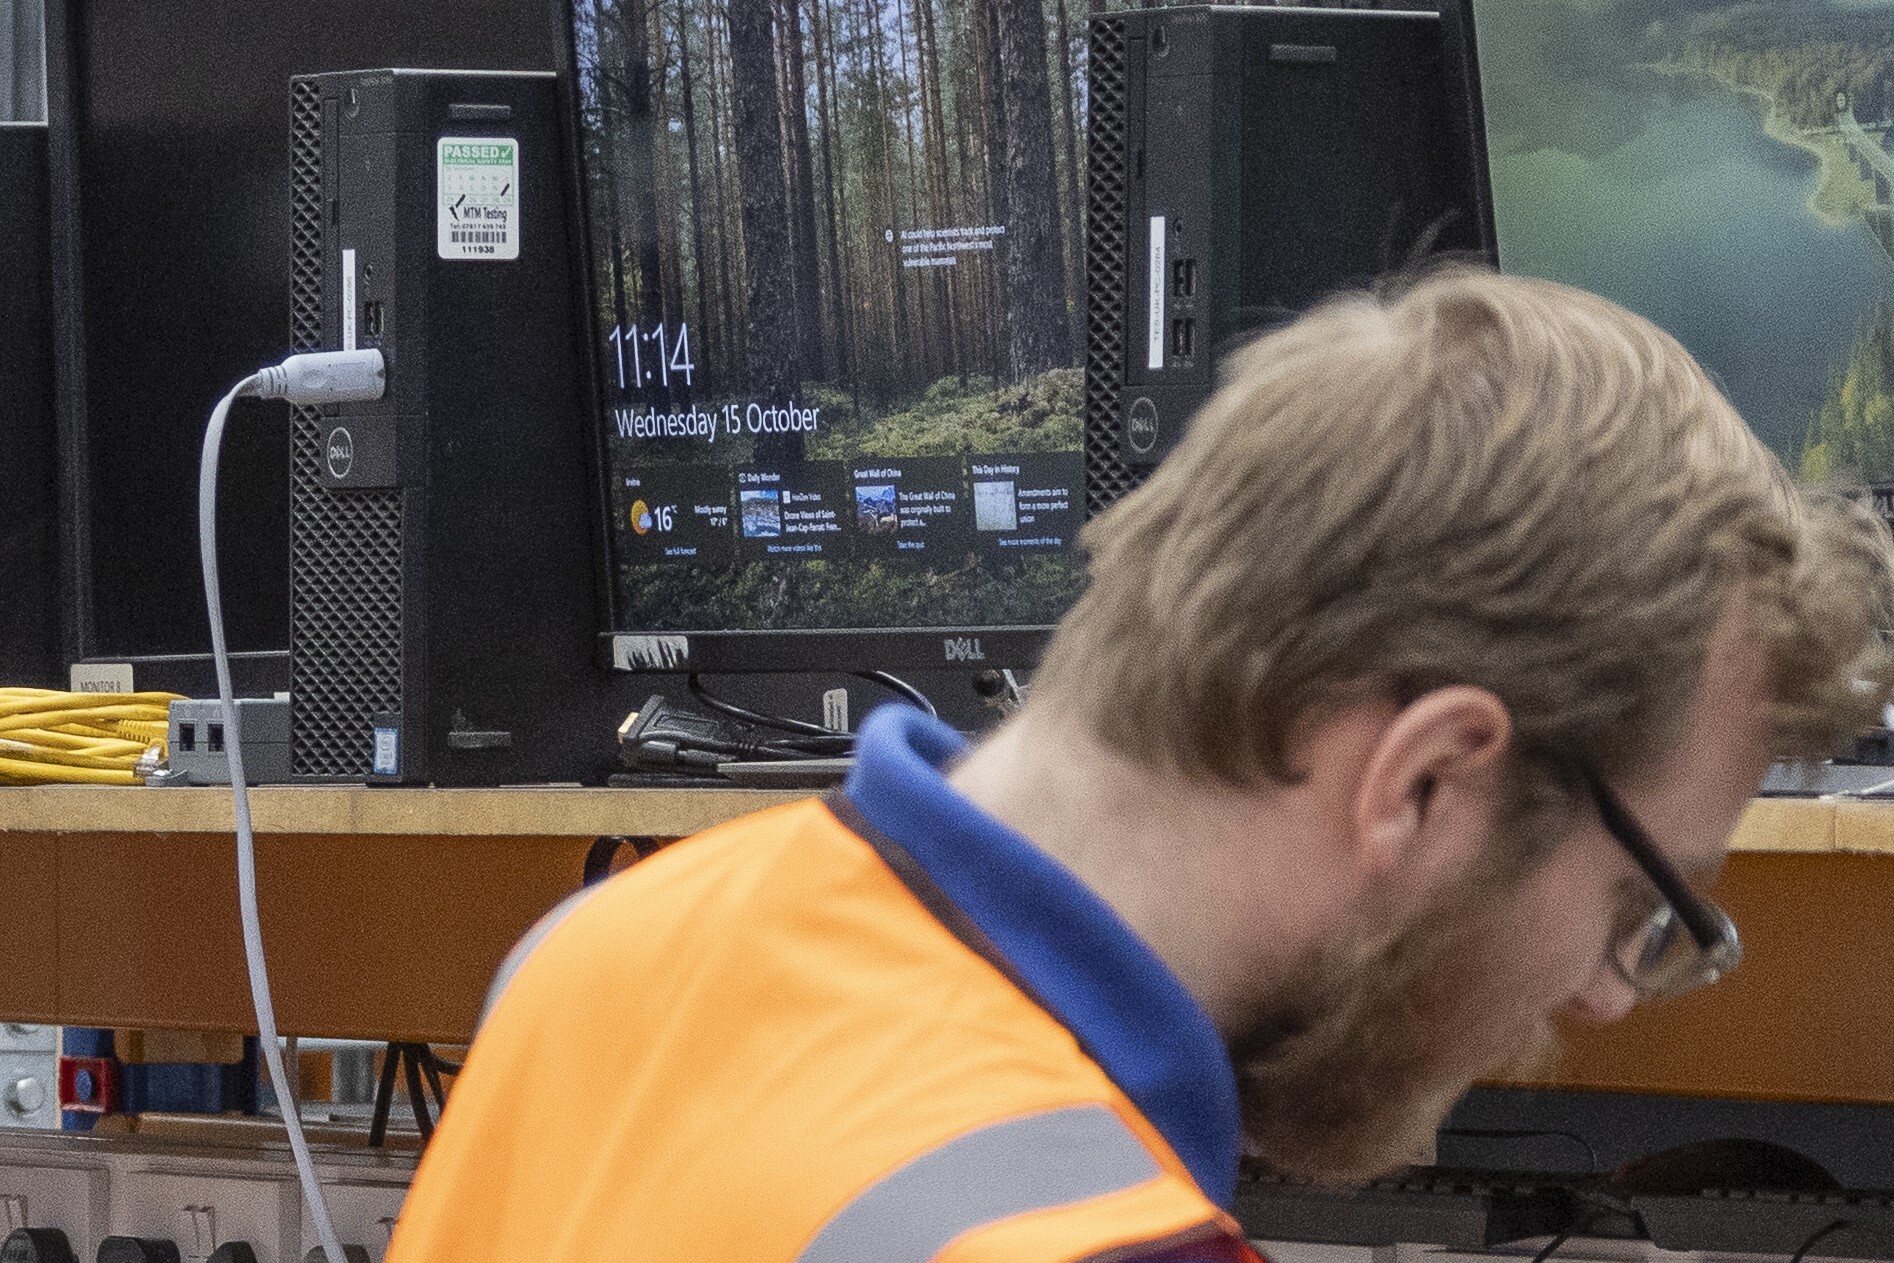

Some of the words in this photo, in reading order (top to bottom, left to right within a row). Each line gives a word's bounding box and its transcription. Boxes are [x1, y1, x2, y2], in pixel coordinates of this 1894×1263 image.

[444, 145, 499, 159] PASSED
[463, 206, 482, 219] MTM
[483, 206, 508, 223] Testing
[609, 322, 695, 389] 11:14
[614, 404, 717, 443] Wednesday
[722, 404, 741, 434] 15
[746, 401, 820, 434] October
[853, 469, 868, 478] Great
[887, 468, 901, 478] China
[908, 492, 923, 501] Great
[941, 490, 956, 500] China
[944, 637, 985, 662] DELL
[80, 680, 114, 693] MONITOR
